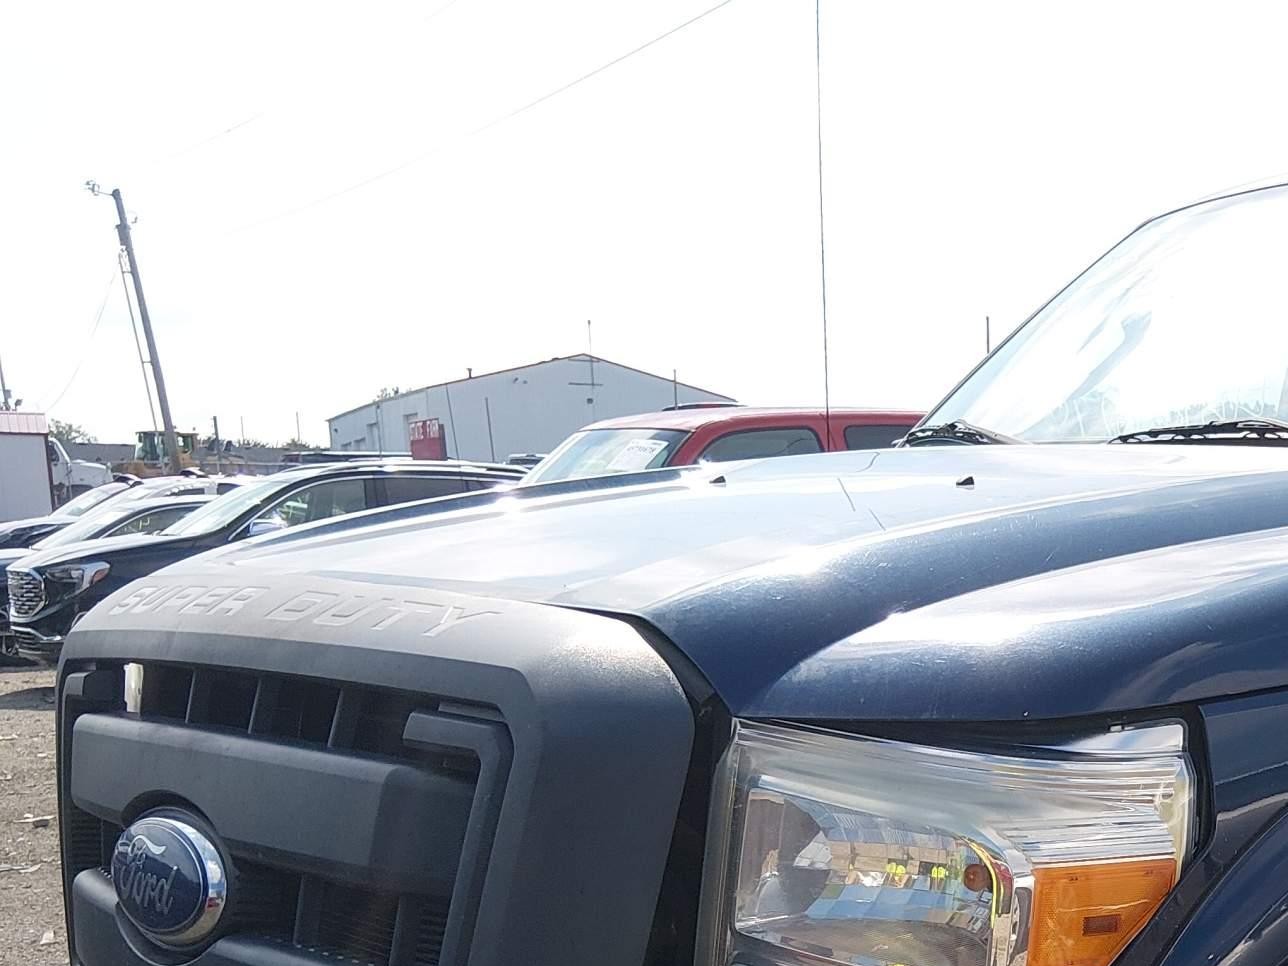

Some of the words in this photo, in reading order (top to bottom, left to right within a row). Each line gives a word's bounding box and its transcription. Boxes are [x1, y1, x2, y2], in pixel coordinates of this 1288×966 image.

[112, 584, 265, 616] SUPER
[266, 589, 501, 636] DUTY
[117, 834, 178, 916] Ford
